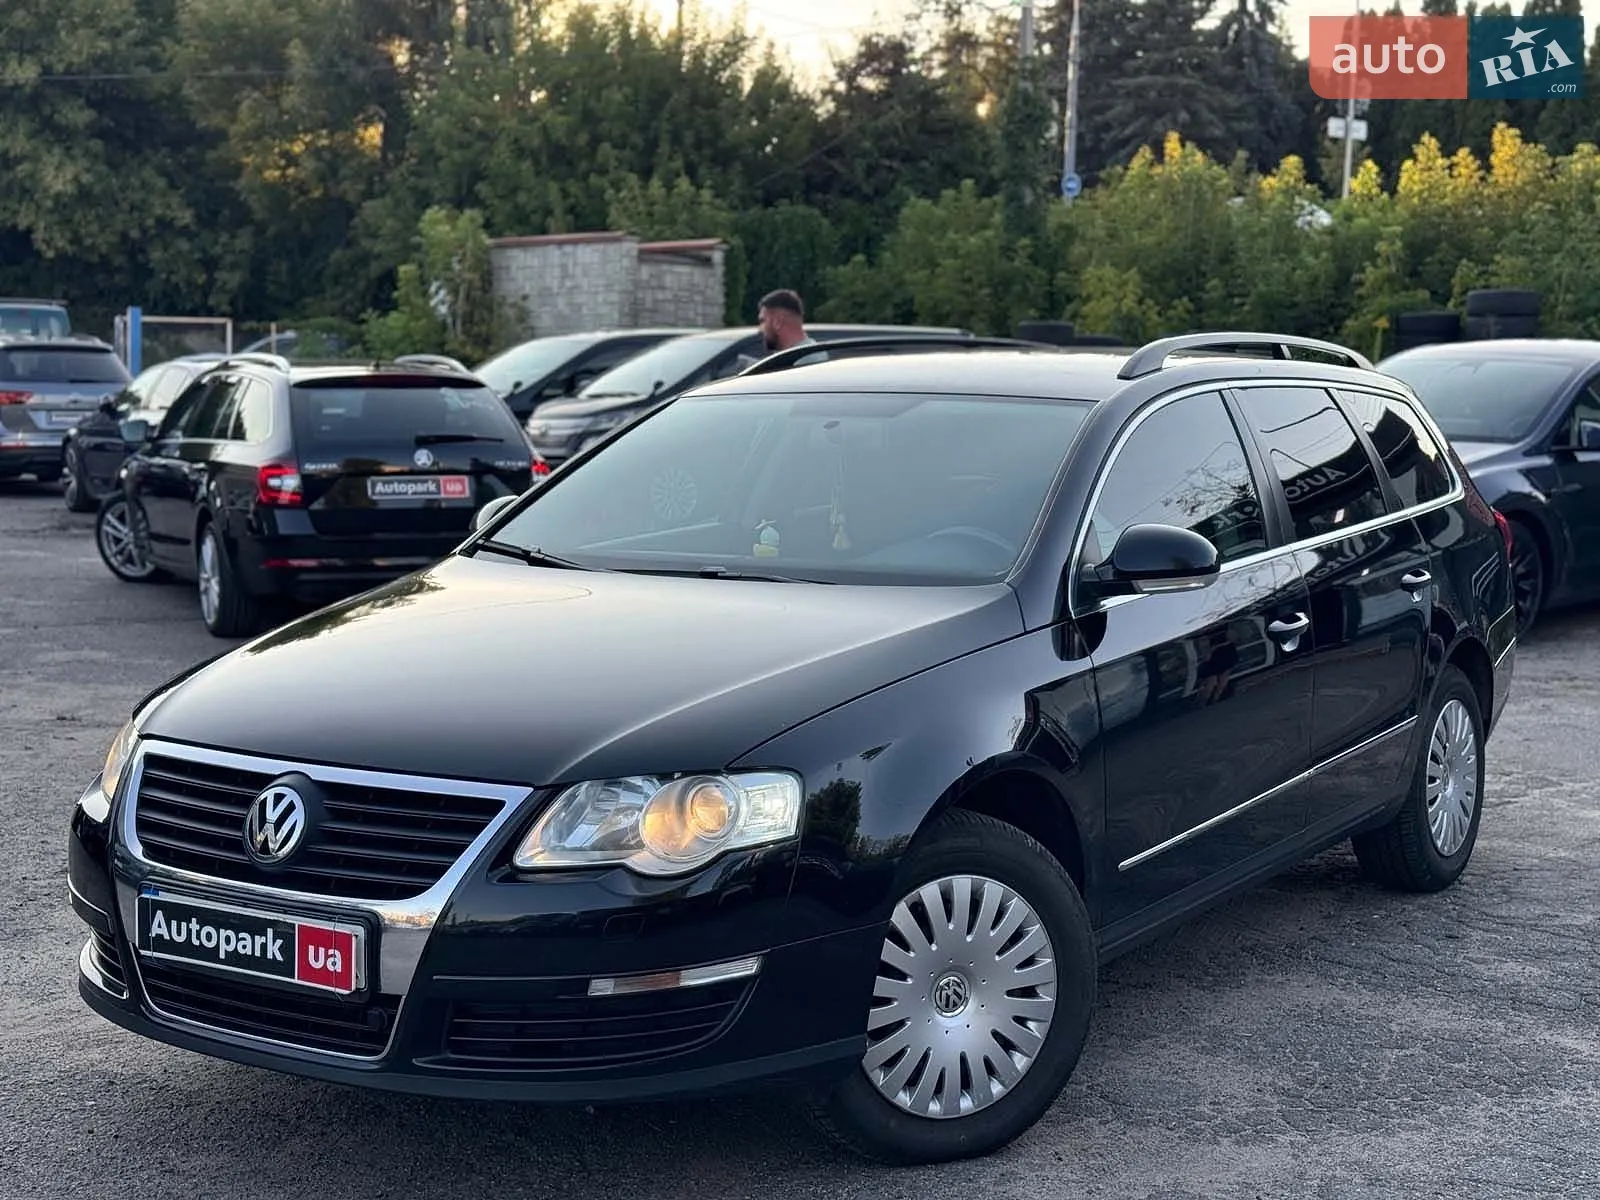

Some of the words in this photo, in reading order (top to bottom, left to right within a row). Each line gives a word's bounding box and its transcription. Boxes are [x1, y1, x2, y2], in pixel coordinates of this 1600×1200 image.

[375, 480, 438, 495] Autopark
[150, 910, 283, 961] Autopark
[308, 944, 342, 973] ua
